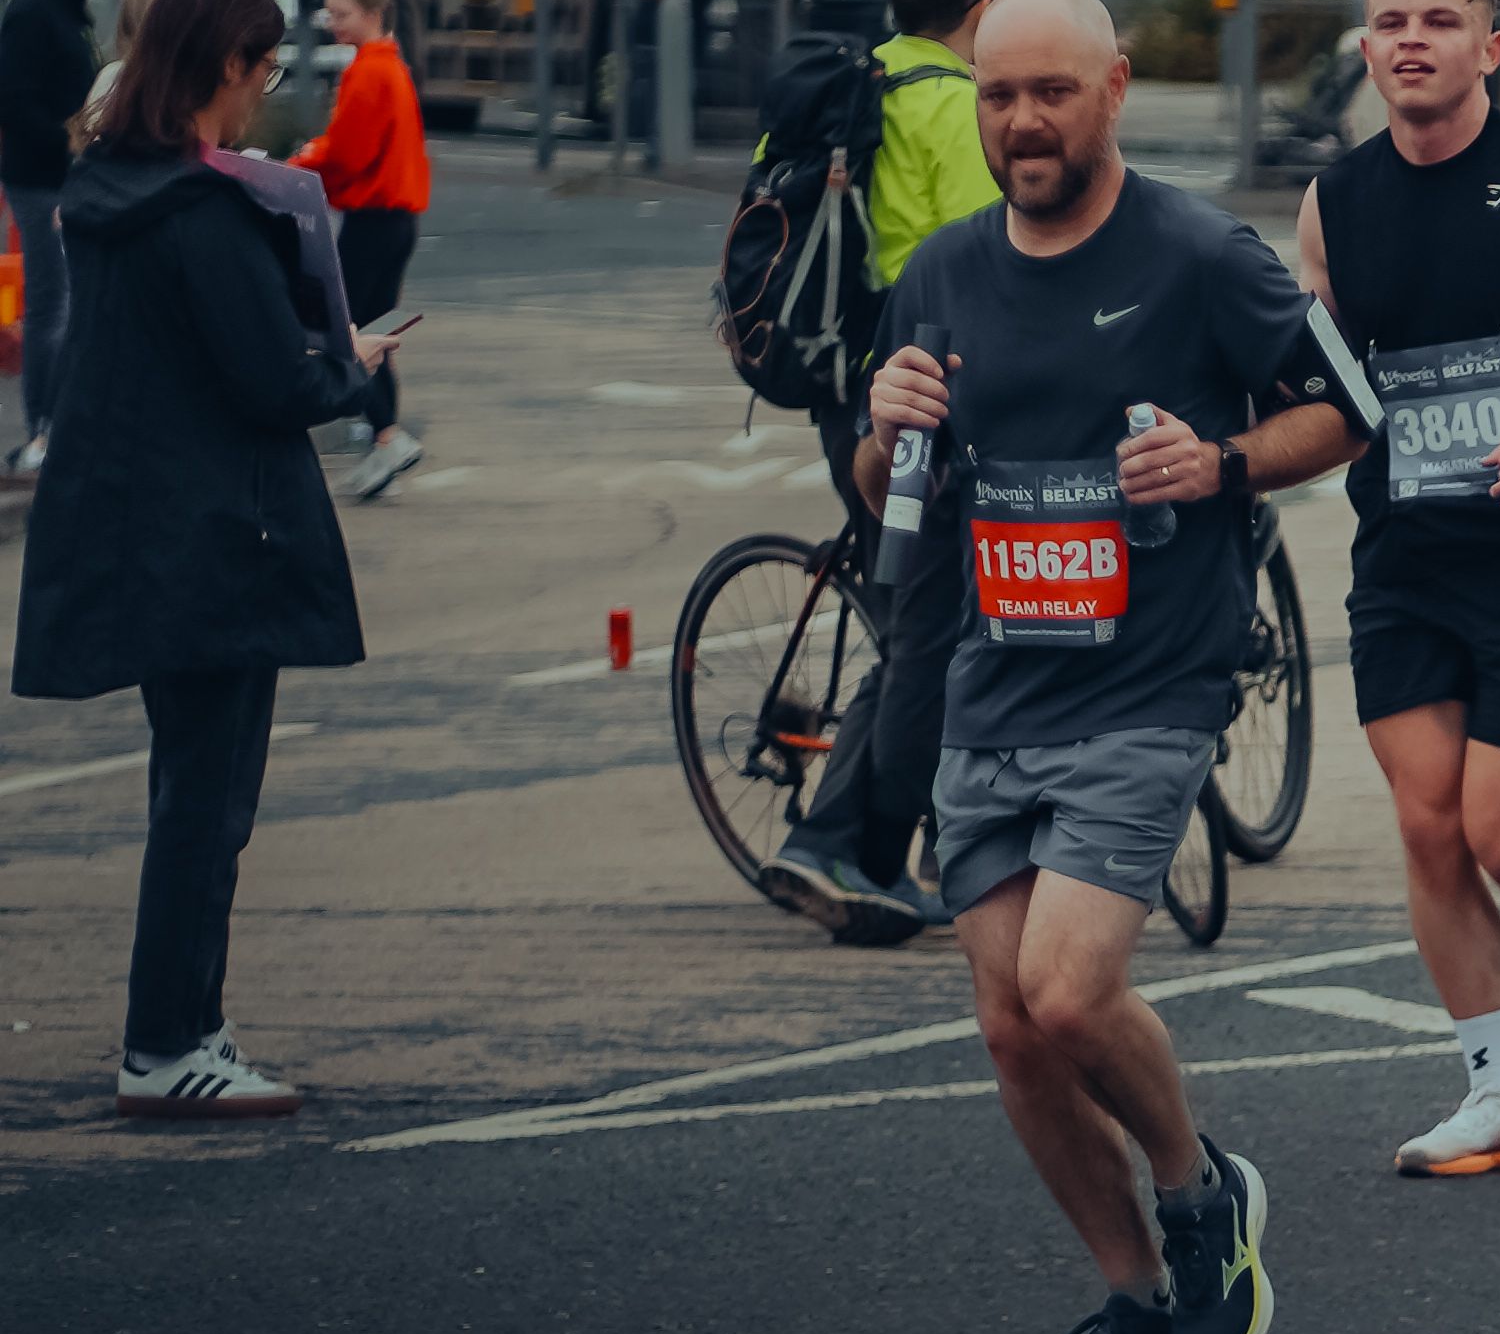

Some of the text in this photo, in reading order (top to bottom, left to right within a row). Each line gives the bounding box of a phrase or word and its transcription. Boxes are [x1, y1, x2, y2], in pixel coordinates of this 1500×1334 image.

[980, 483, 1119, 504] Phoenix BELFAST
[977, 538, 1119, 581] 11562B
[997, 599, 1098, 616] TEAM RELAY
